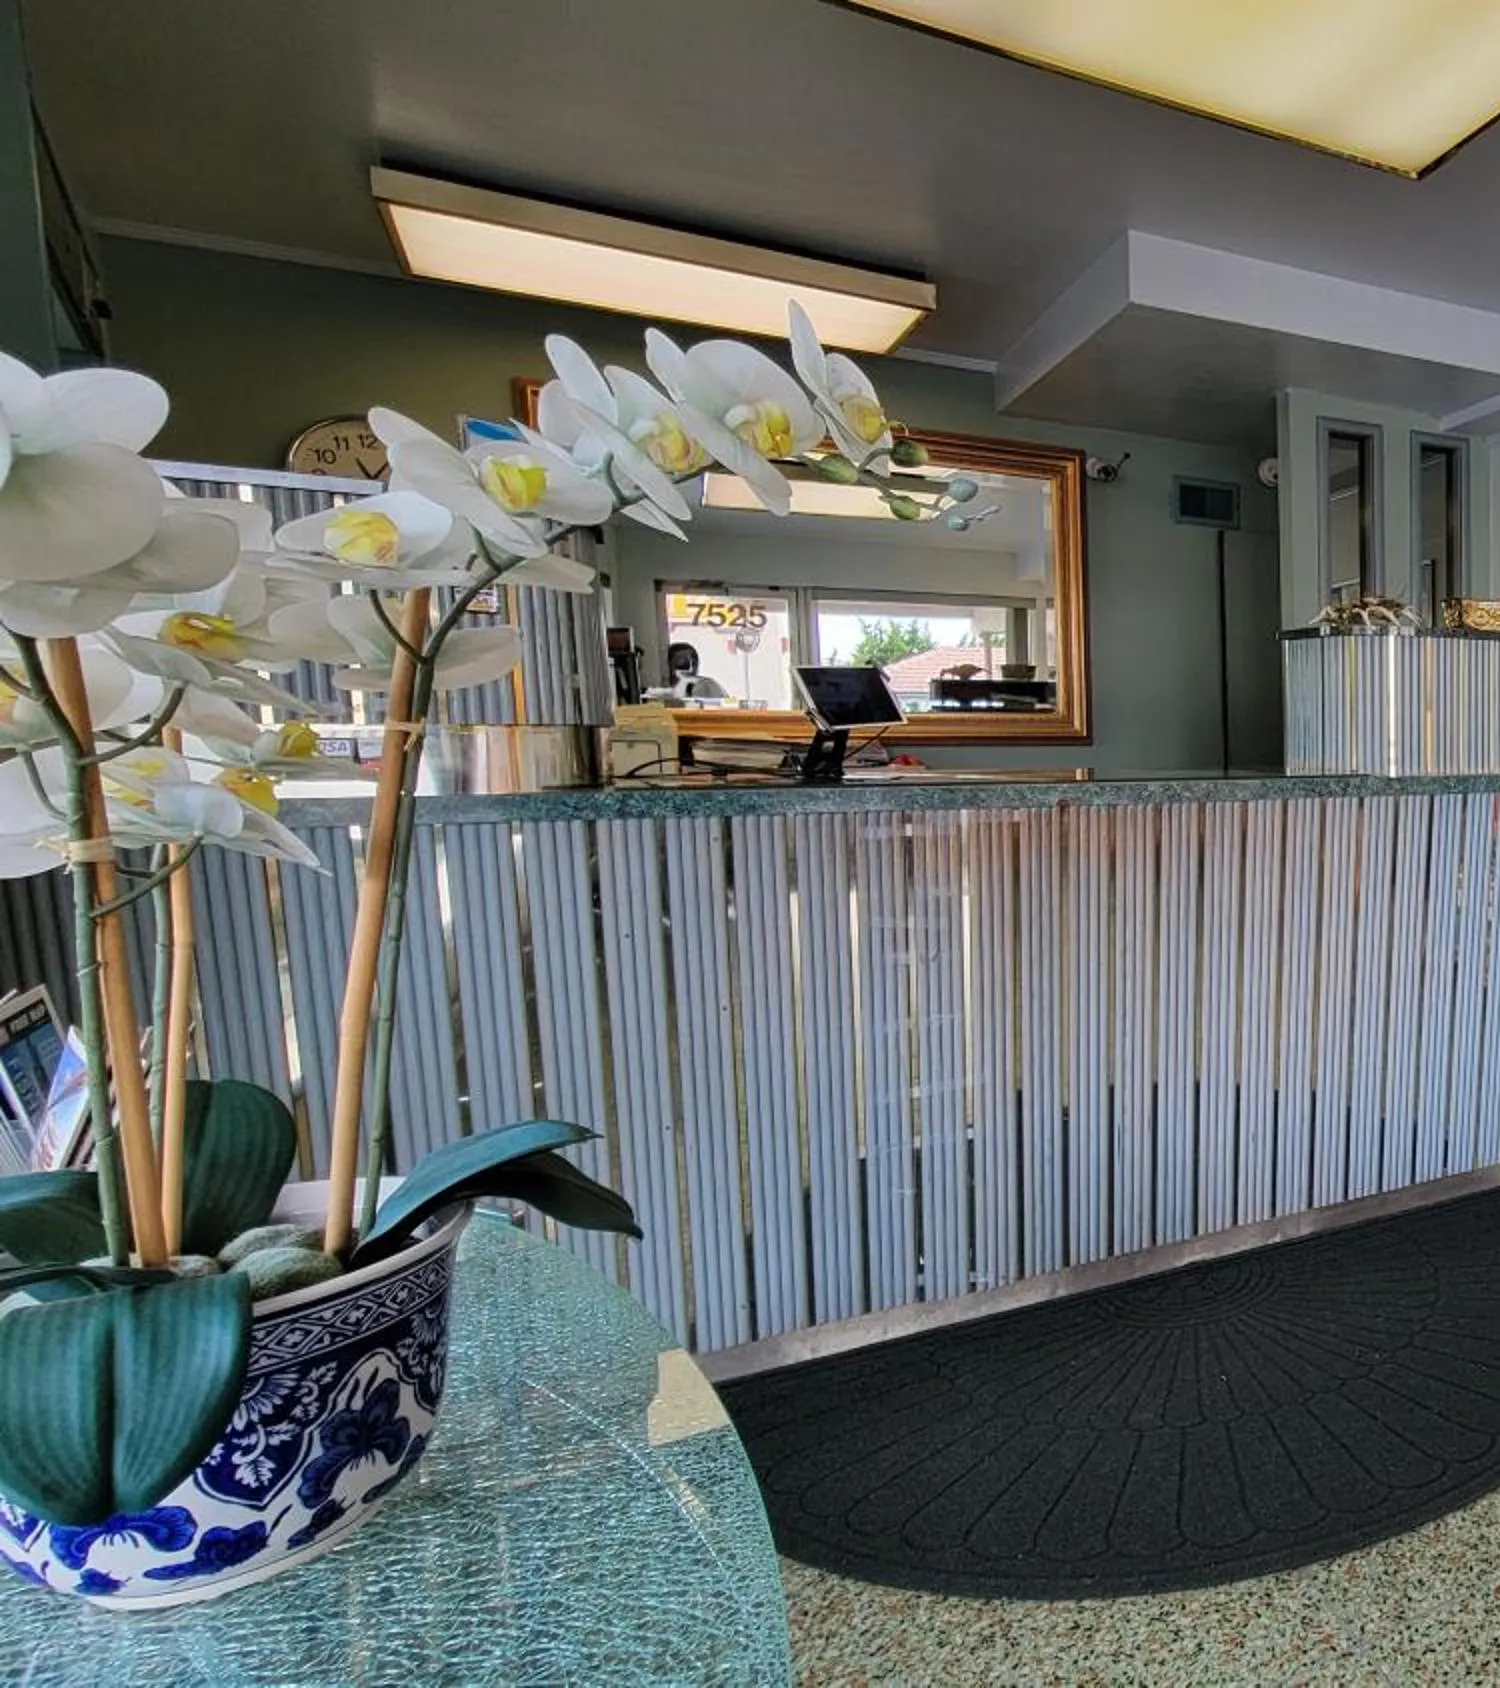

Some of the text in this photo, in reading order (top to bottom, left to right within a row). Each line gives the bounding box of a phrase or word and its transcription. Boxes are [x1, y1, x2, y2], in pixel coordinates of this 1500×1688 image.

[334, 436, 349, 450] 11
[358, 434, 378, 449] 12
[314, 448, 337, 464] 10
[686, 603, 767, 628] 7525
